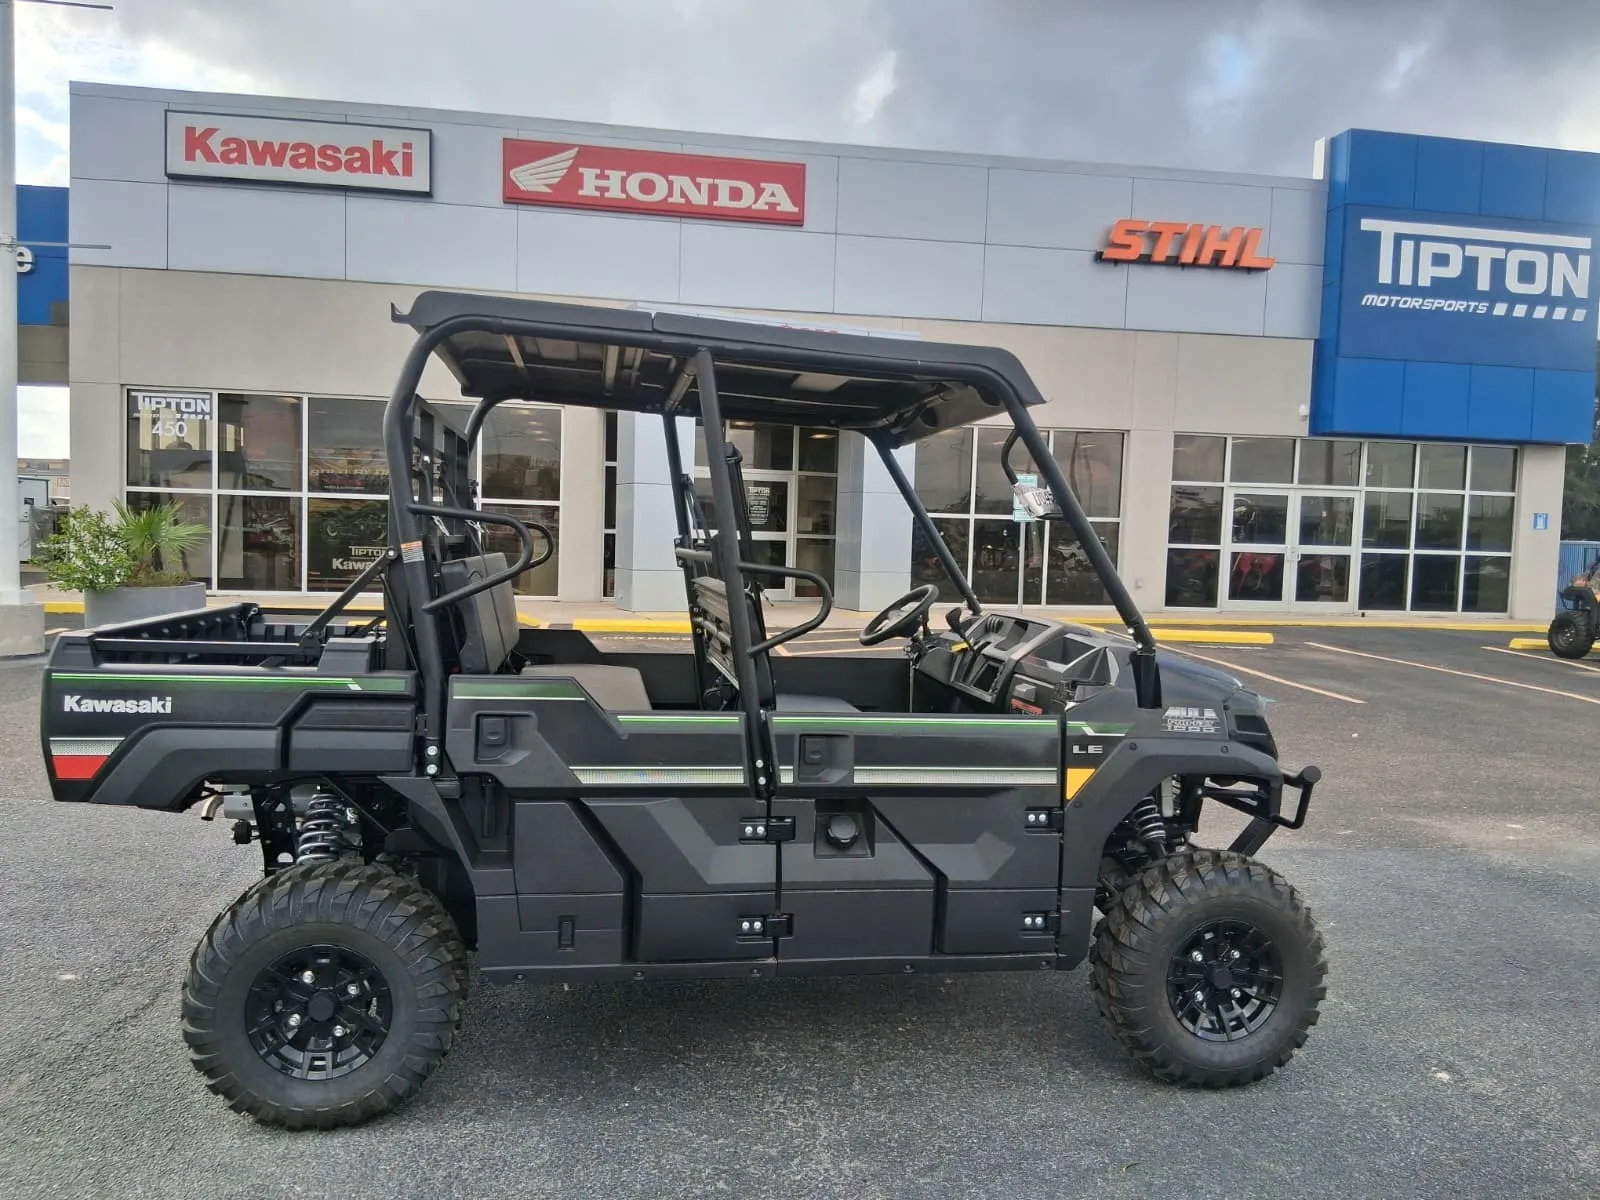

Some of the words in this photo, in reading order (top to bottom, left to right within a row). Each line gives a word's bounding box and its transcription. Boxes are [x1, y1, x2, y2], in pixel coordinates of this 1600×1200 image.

[184, 126, 413, 177] Kawasaki
[578, 167, 799, 212] HONDA
[1101, 218, 1277, 270] STIHL
[1360, 218, 1592, 299] TIPTON
[1361, 293, 1489, 315] MOTORSPORTS
[130, 391, 211, 413] TIPTON
[151, 421, 188, 437] 450
[63, 695, 172, 713] Kawasaki
[1072, 744, 1104, 754] LE
